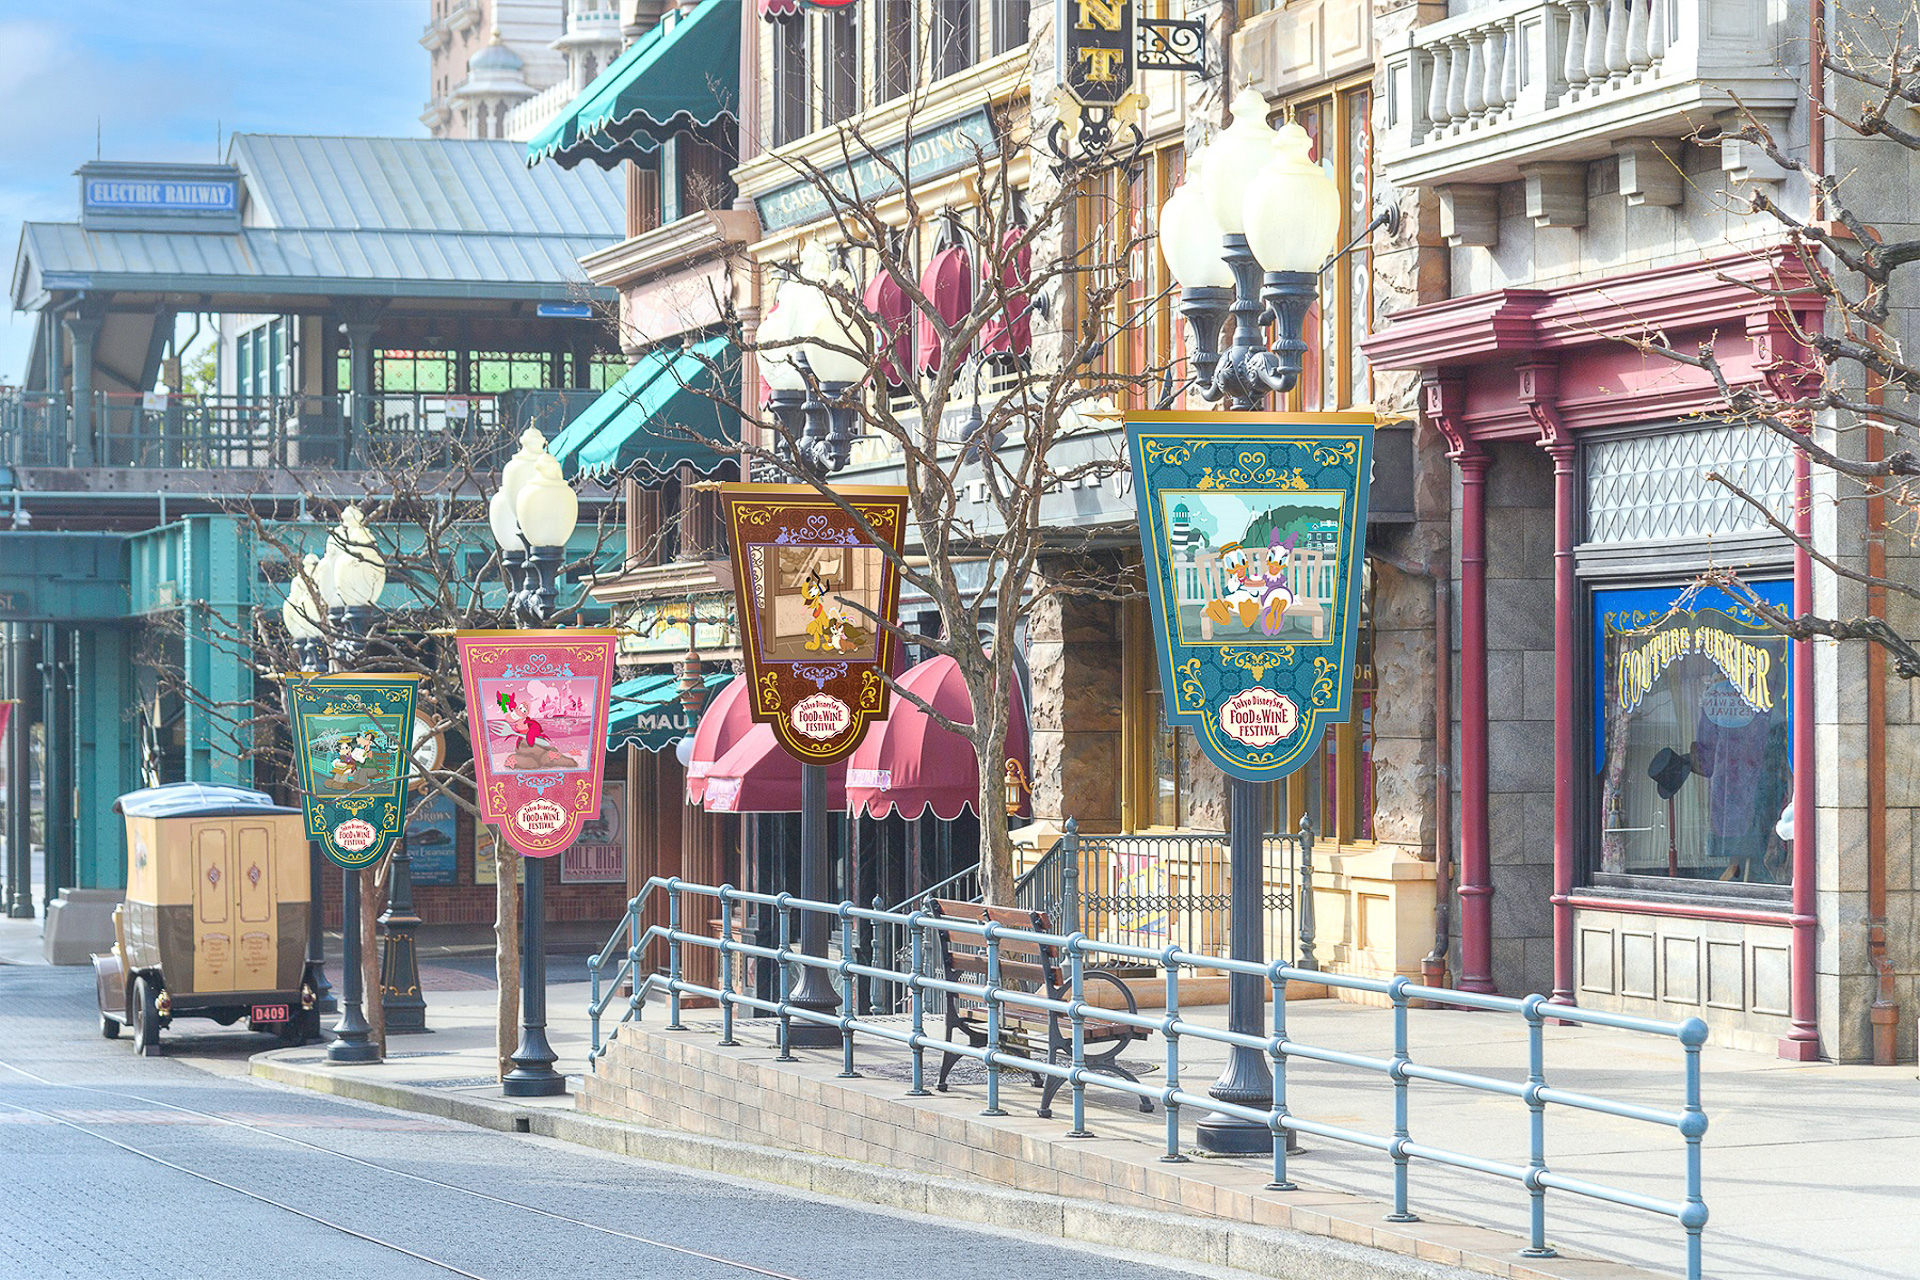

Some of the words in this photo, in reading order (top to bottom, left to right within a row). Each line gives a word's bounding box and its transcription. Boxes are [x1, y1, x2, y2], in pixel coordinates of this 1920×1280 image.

[781, 167, 865, 214] CARCCI
[868, 126, 970, 181] BILDING
[93, 183, 161, 202] ELECTRIC
[165, 185, 227, 204] RAILWAY
[1618, 627, 1691, 714] COUTURE
[1695, 625, 1774, 713] FURRIER
[1231, 698, 1252, 710] Tokyo
[799, 710, 818, 722] FOOD
[1230, 709, 1255, 724] FOOD
[805, 722, 836, 732] FESTIVAL
[1239, 724, 1280, 736] FESTIVAL
[528, 821, 555, 830] FESTIVAL
[564, 846, 593, 870] MILE
[595, 845, 623, 869] HIGH
[255, 1007, 285, 1021] D409
